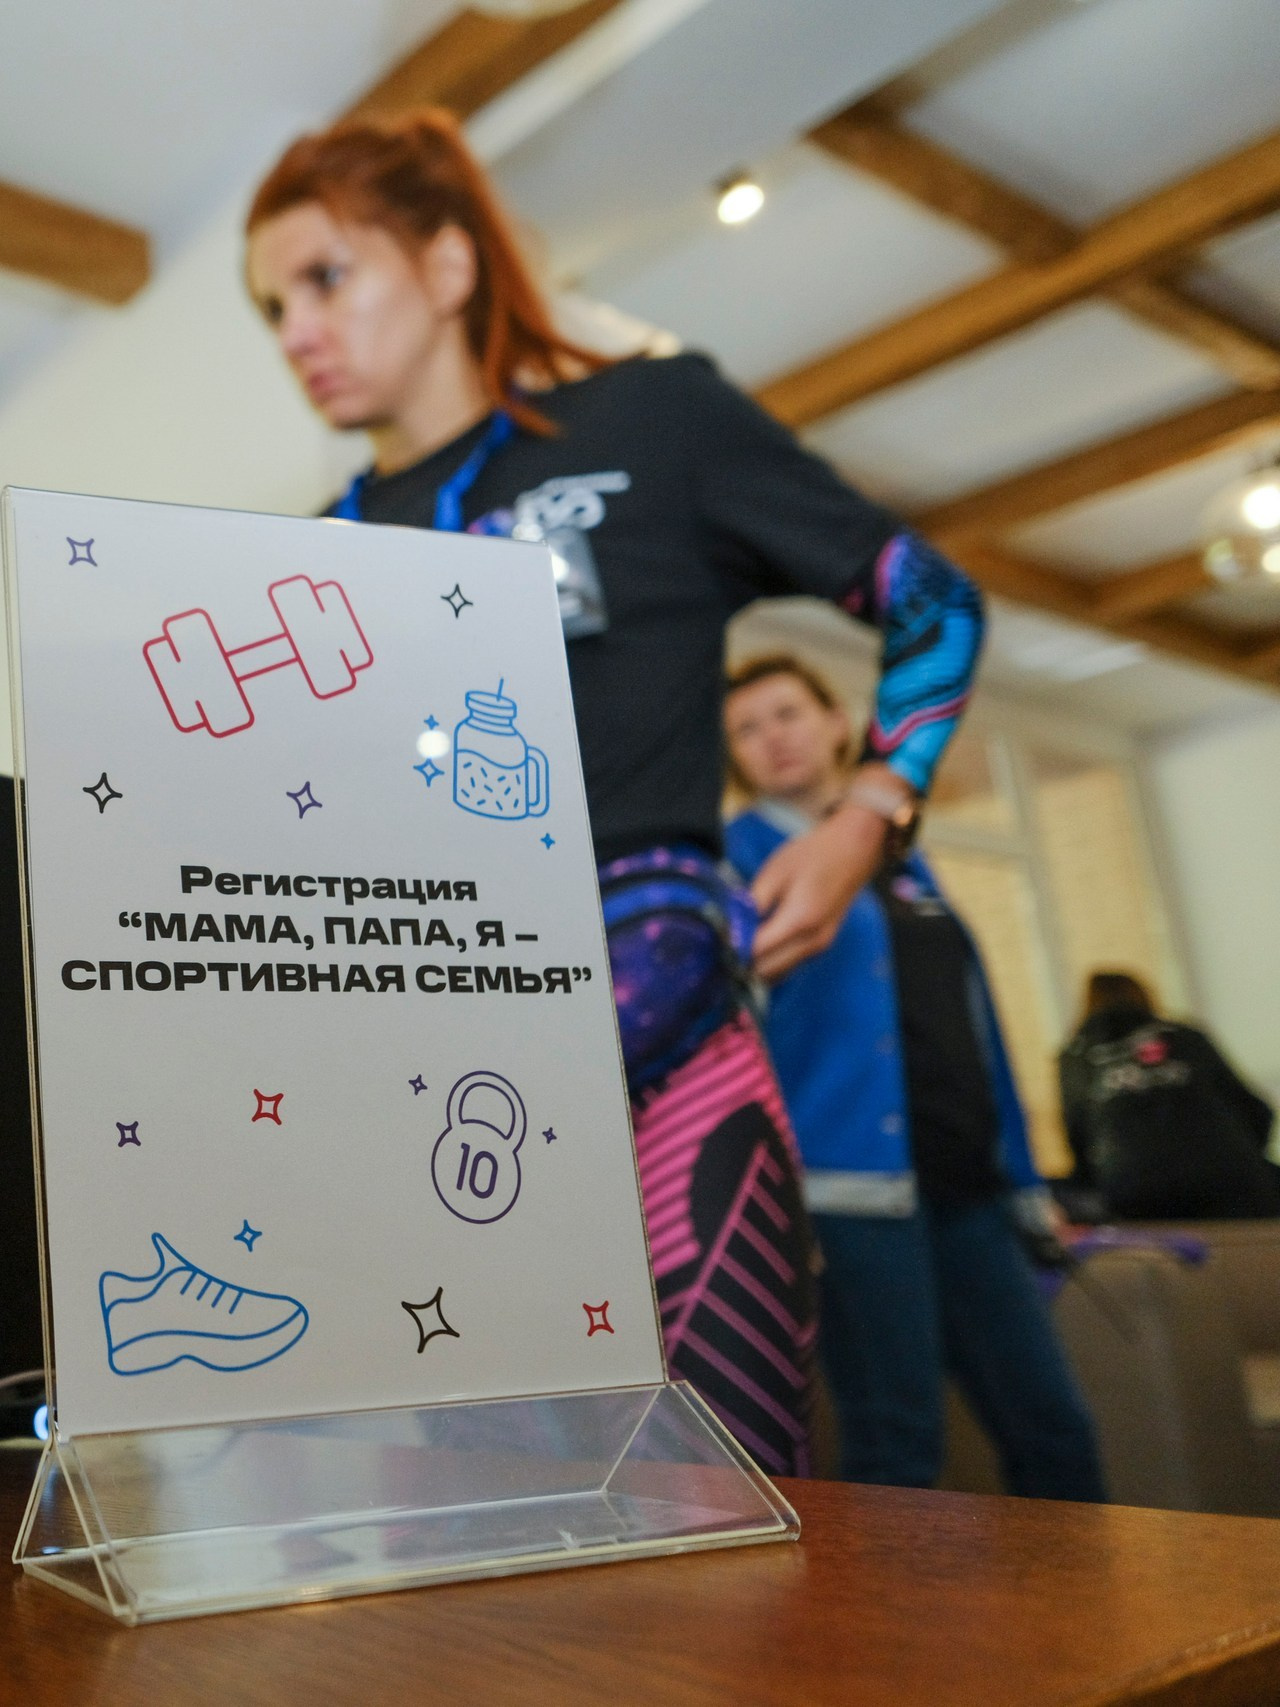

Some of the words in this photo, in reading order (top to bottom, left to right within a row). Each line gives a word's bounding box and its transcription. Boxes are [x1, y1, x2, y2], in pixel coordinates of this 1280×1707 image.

[180, 865, 478, 906] Регистрация
[118, 911, 315, 951] “МАМА,
[323, 916, 467, 954] ПАПА,
[475, 920, 506, 948] Я
[61, 959, 407, 993] СПОРТИВНАЯ
[415, 964, 592, 994] СЕМЬЯ”
[456, 1142, 498, 1199] 10
